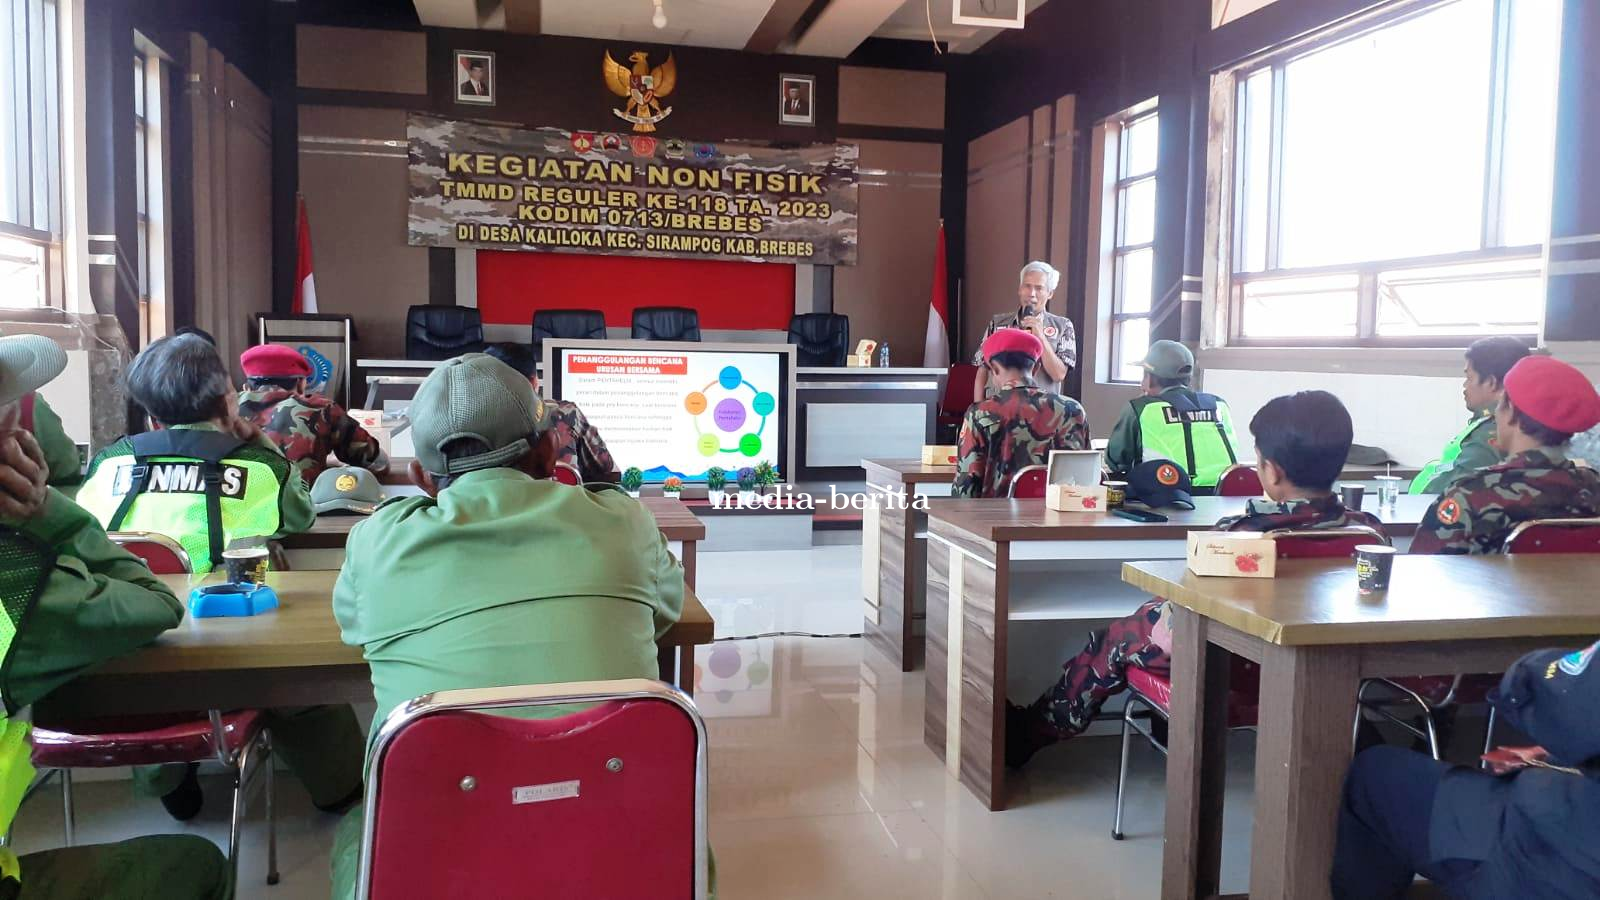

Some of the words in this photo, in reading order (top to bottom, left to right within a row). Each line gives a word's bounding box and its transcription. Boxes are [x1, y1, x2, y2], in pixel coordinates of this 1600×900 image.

[448, 153, 633, 183] KEGIATAN
[648, 165, 720, 189] NON
[735, 171, 823, 194] FISIK
[440, 181, 514, 200] TMMD
[524, 186, 638, 208] REGULER
[647, 193, 727, 213] KE-118
[735, 199, 771, 216] TA.
[778, 201, 831, 218] 2023
[518, 204, 599, 224] KODIM
[608, 210, 763, 232] 0713/BREBES
[458, 224, 474, 241] DI
[480, 225, 520, 242] DESA
[525, 227, 602, 247] KALILOKA
[607, 232, 641, 249] KEC.
[646, 233, 721, 252] SIRAMPOG
[726, 237, 814, 256] KAB.BREBES
